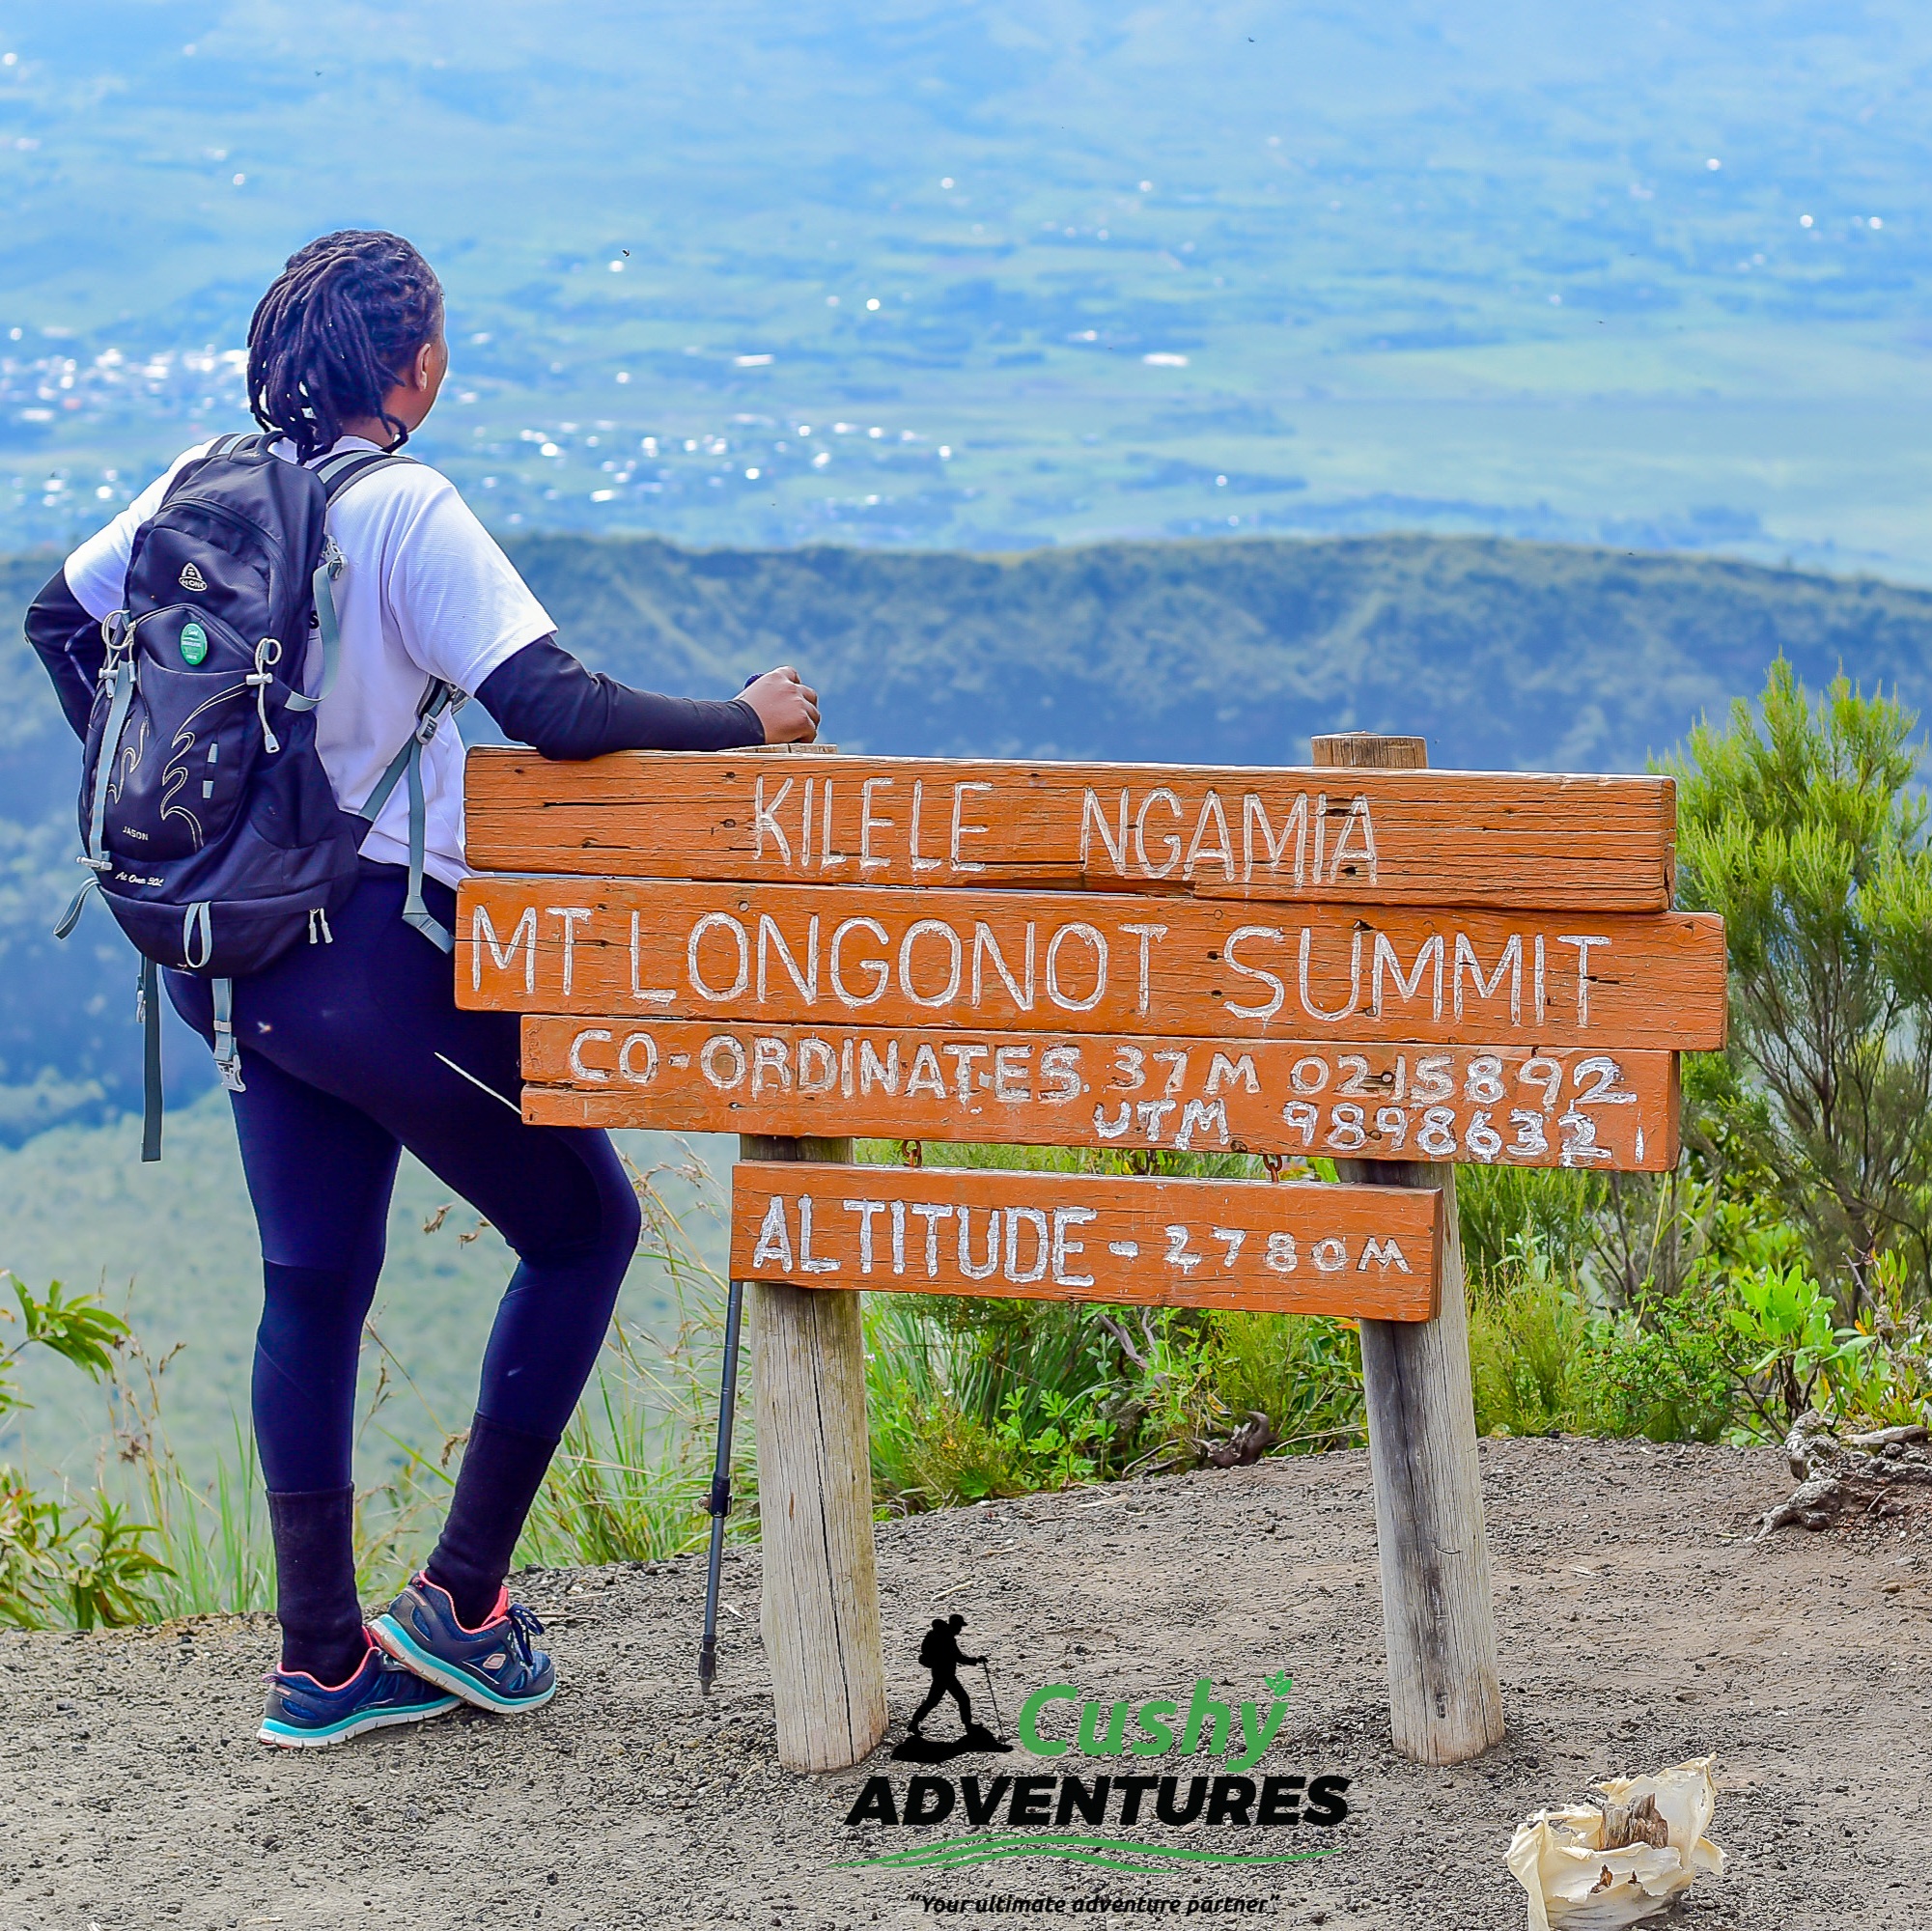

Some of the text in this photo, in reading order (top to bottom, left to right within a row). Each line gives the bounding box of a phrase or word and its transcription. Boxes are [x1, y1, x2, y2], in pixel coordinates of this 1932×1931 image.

[122, 826, 149, 841] JASON
[752, 774, 1378, 889] KILELE NGAMIA
[471, 905, 1611, 1029] MT LONGONOT SUMMIT
[568, 1028, 1082, 1105] CO-ORDINATES
[1092, 1097, 1230, 1151] UTM
[752, 1192, 1097, 1288] ALTITUDE
